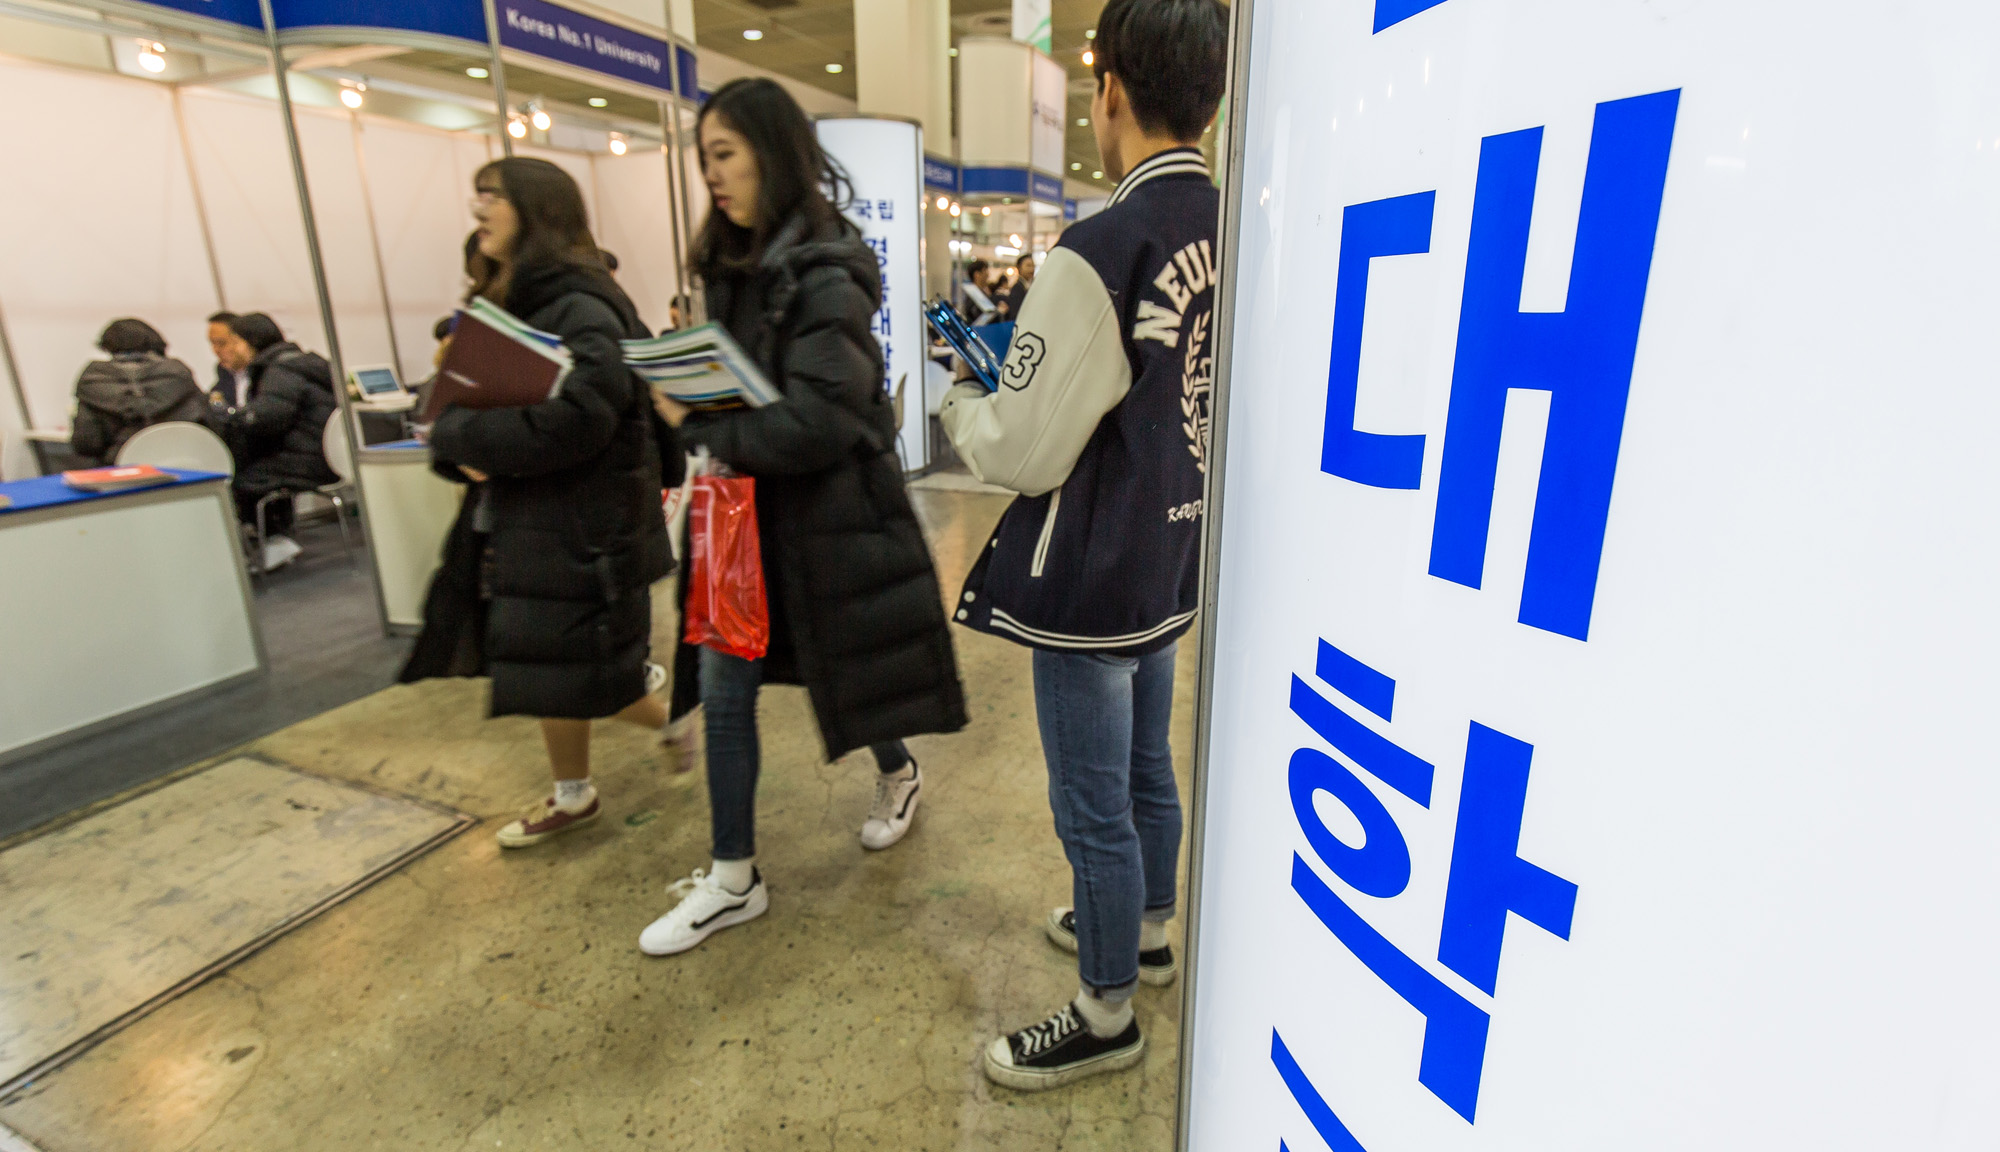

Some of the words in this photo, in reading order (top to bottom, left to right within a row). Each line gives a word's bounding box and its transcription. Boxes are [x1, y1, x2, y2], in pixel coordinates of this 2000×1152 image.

[506, 7, 556, 41] Korea
[557, 23, 592, 50] No.1
[594, 34, 662, 74] University
[1002, 324, 1046, 392] 3
